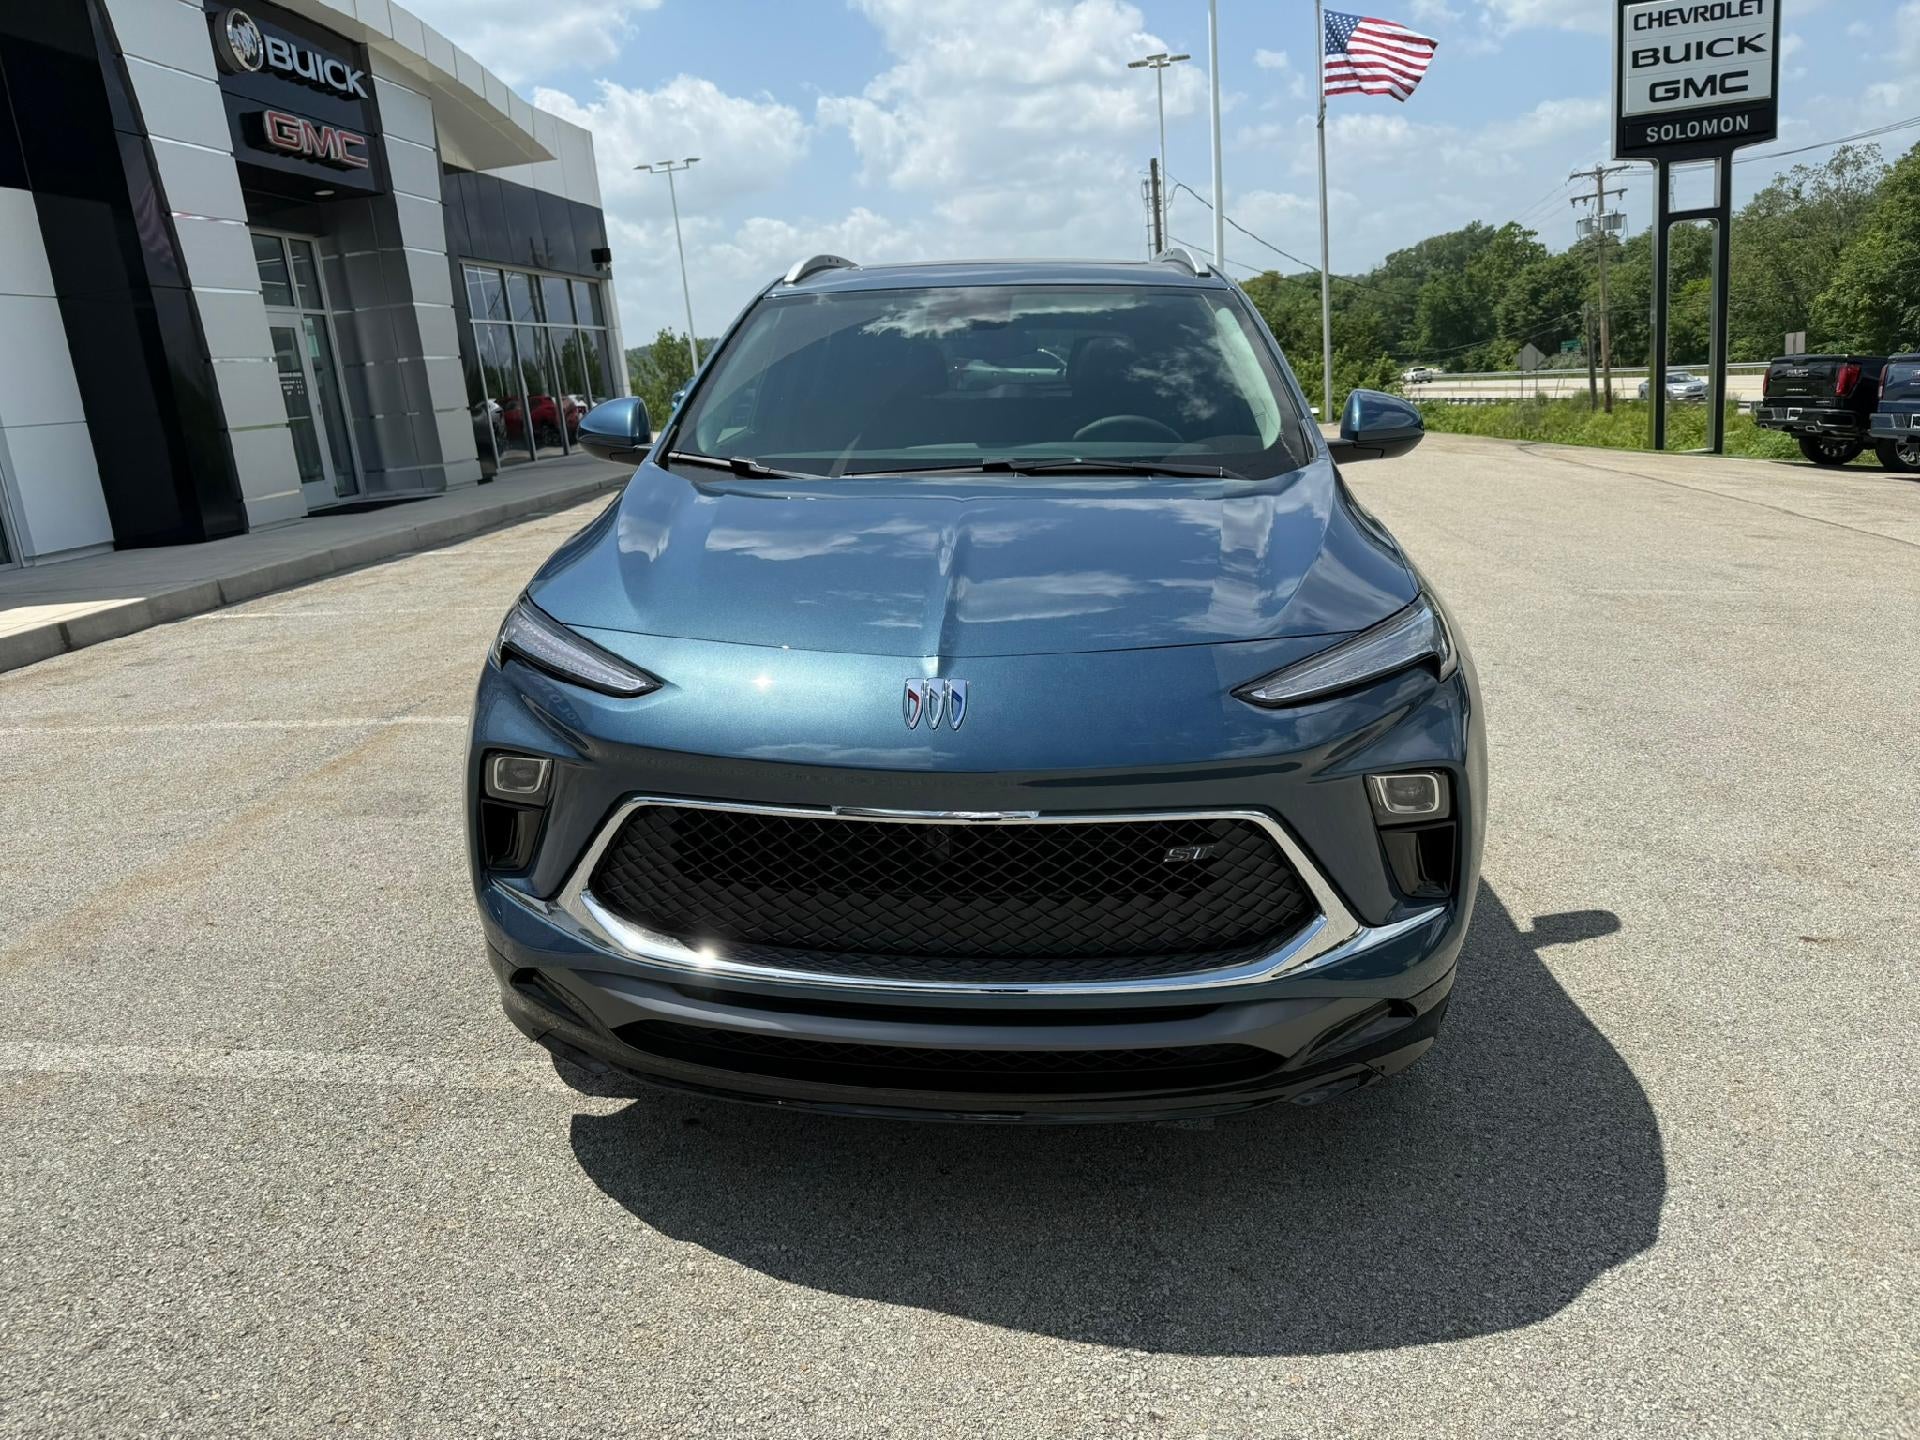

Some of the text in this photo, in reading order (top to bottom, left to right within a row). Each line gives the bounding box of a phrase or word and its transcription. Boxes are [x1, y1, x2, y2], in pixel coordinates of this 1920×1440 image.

[1633, 0, 1763, 31] CHEVROLET
[262, 33, 368, 99] BUICK
[1631, 32, 1768, 69] BUICK
[1649, 69, 1749, 103] GMC
[262, 108, 369, 169] GMC
[1646, 114, 1749, 143] SOLOMON
[1163, 844, 1215, 863] ST
